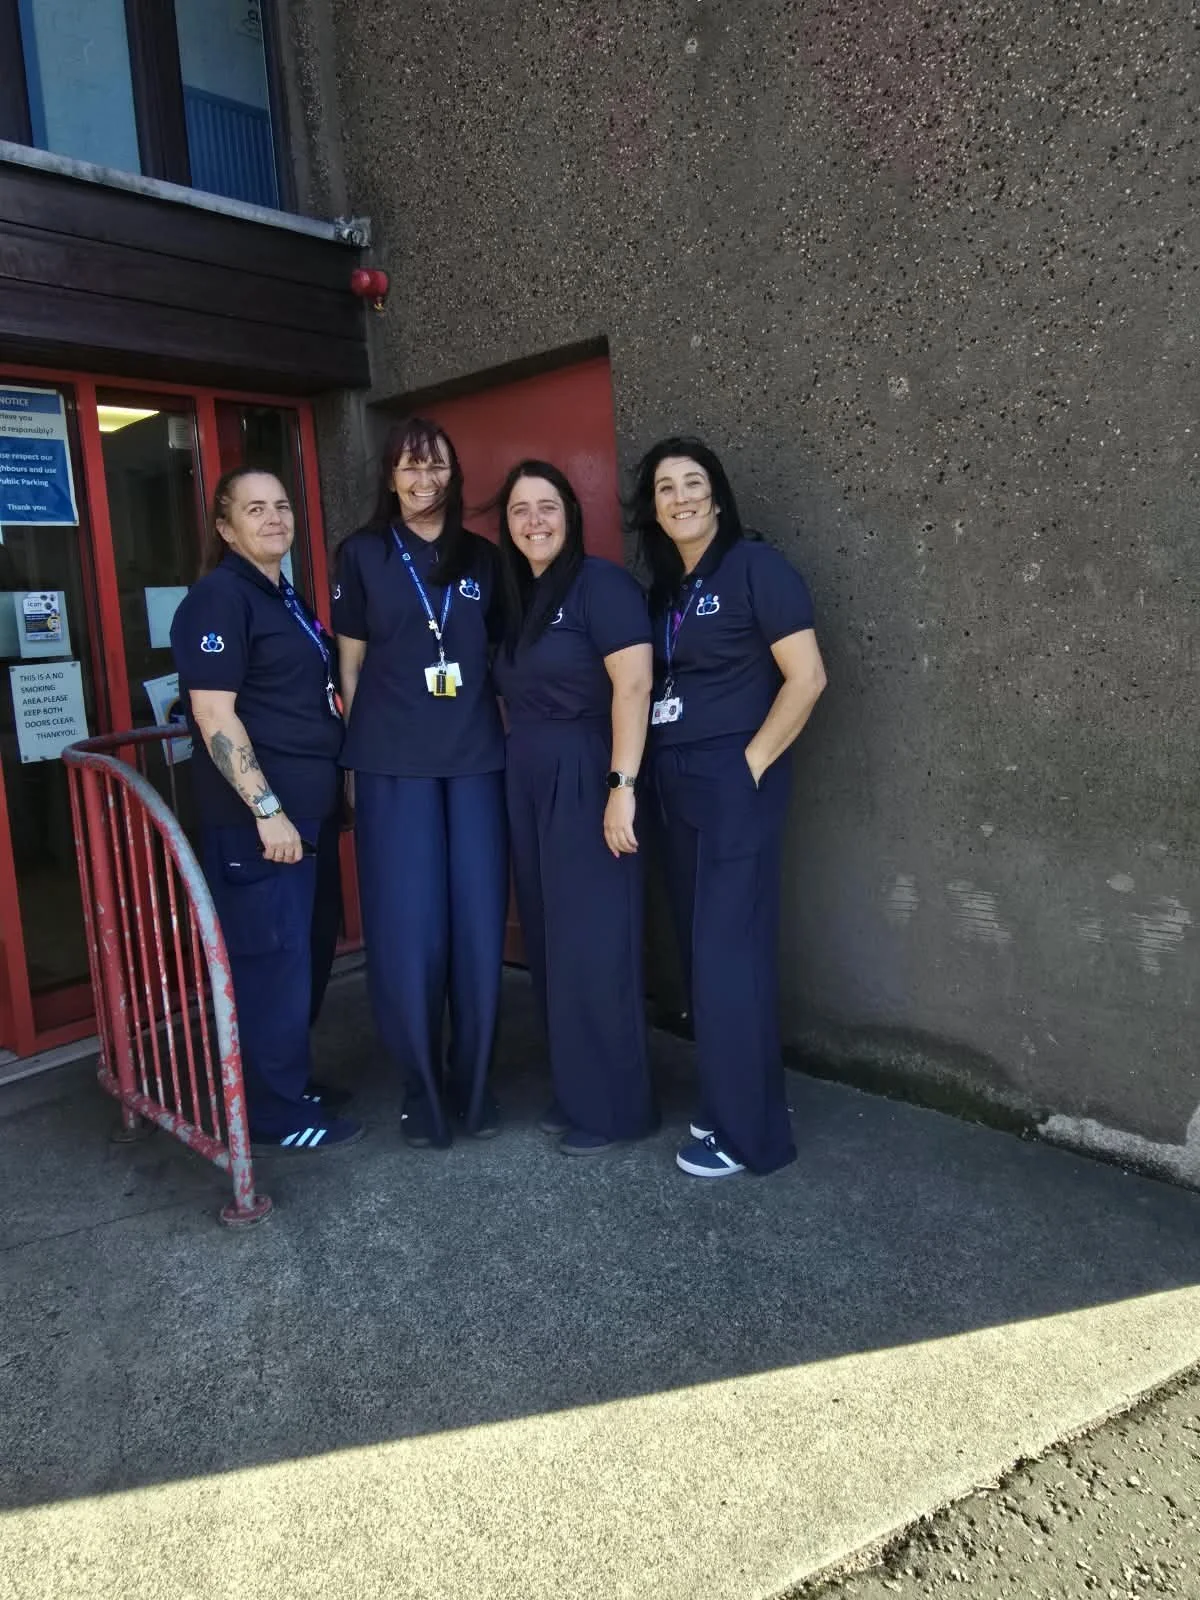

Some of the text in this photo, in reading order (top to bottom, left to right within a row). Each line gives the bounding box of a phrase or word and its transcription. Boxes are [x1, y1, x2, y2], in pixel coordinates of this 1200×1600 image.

[7, 426, 54, 436] responsibly?
[12, 453, 39, 461] respect
[21, 478, 49, 487] Parking
[7, 503, 31, 511] Thank
[52, 671, 64, 679] NO
[20, 684, 56, 694] SMOKING
[23, 706, 63, 717] KEEP BOTH
[25, 719, 51, 729] DOORS
